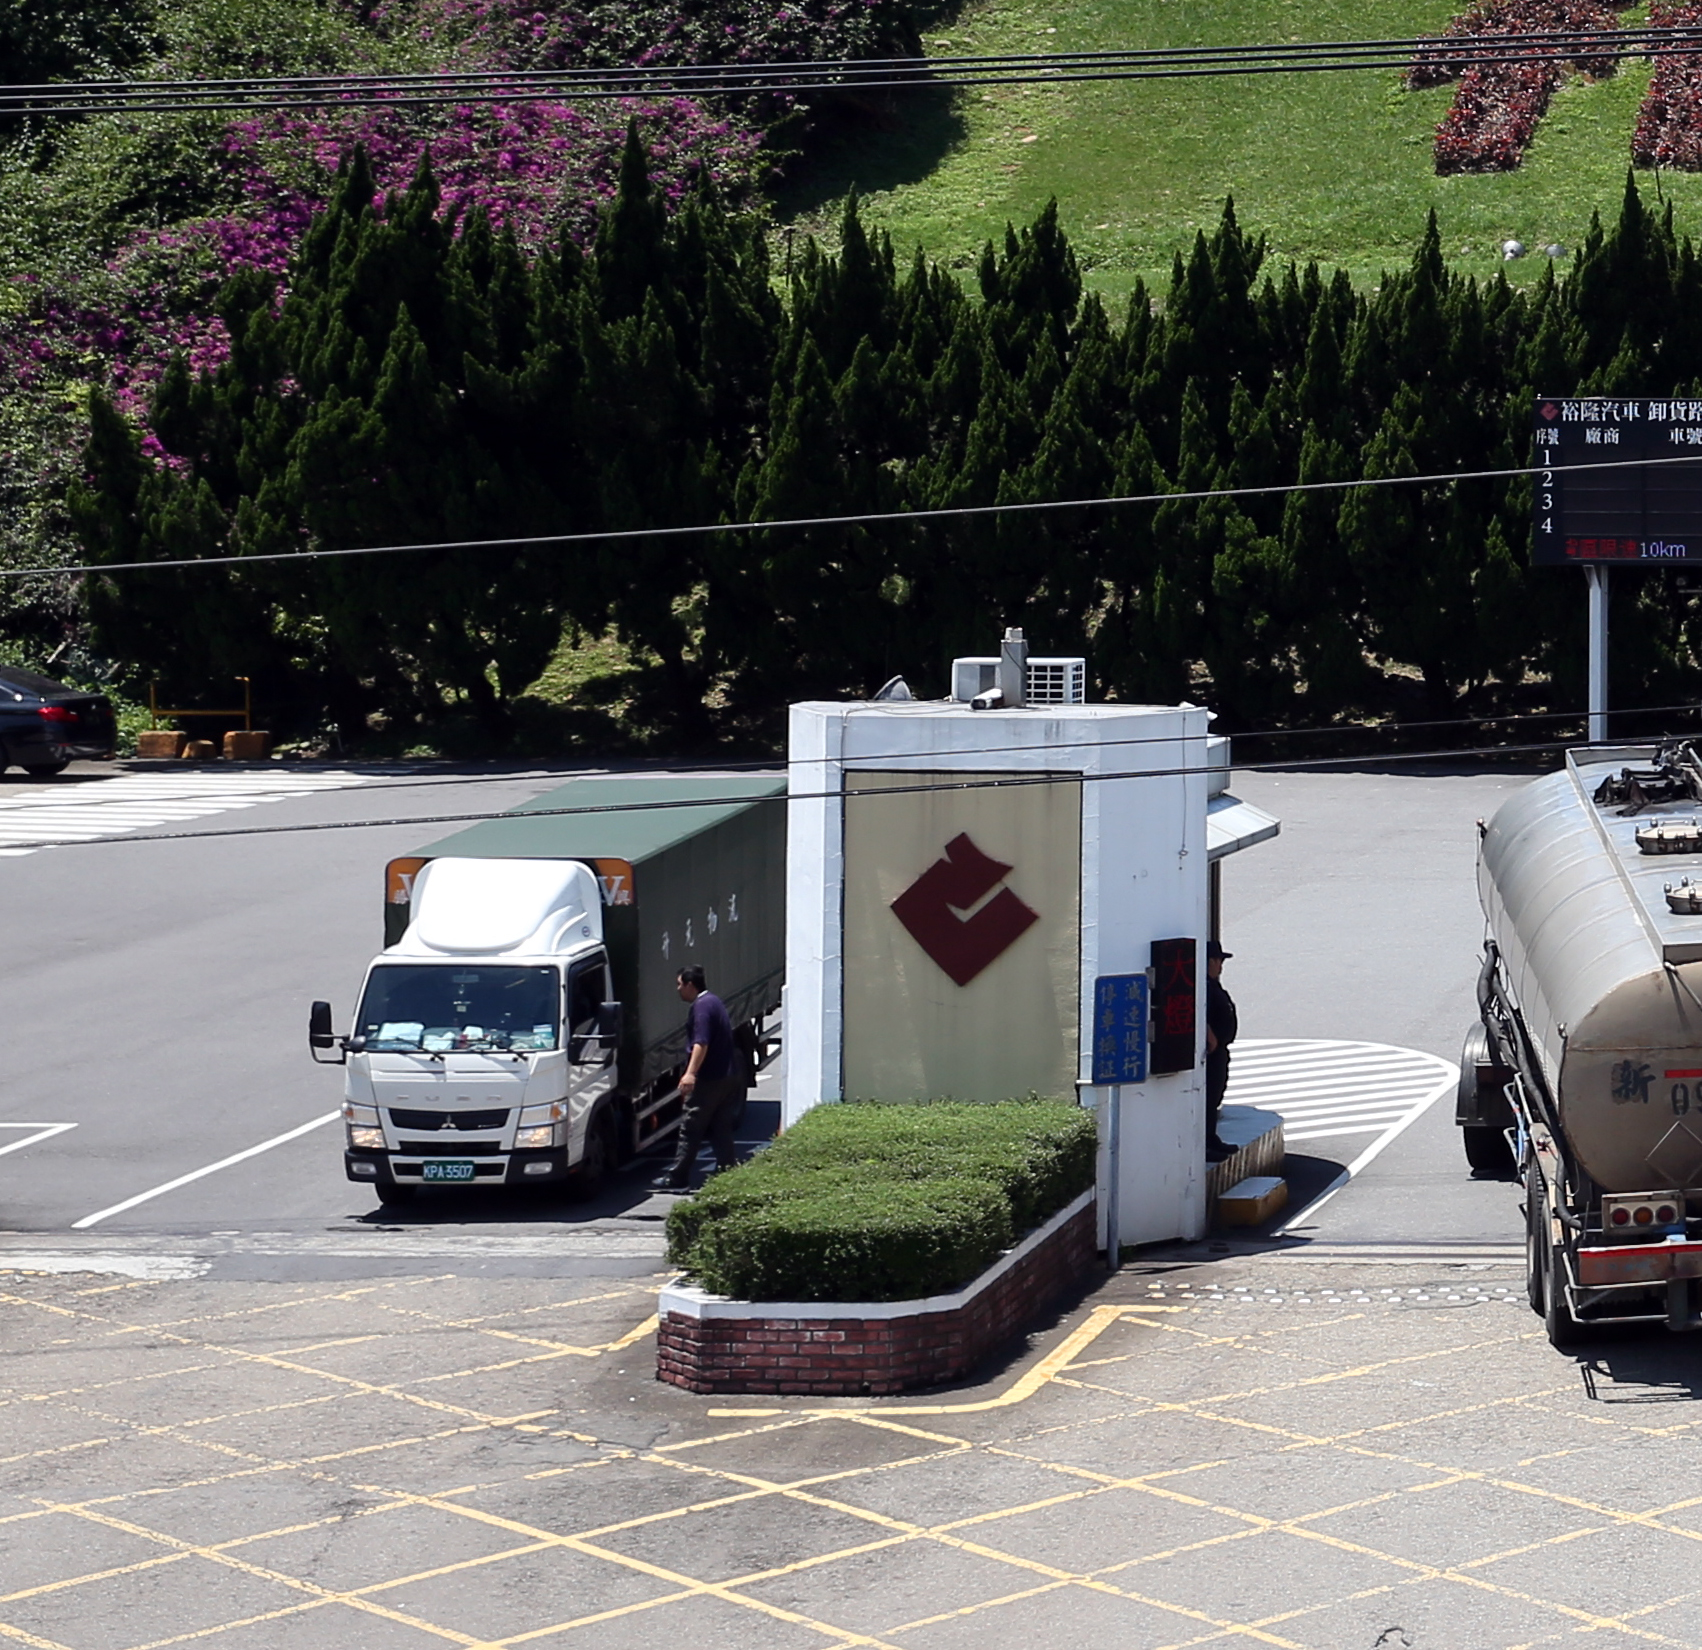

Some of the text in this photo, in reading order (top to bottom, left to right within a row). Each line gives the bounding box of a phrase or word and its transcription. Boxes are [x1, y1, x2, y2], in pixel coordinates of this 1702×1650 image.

[1561, 401, 1641, 422] 裕隆汽車
[1536, 429, 1560, 445] 序號
[1585, 427, 1620, 445] 廠商
[1543, 450, 1551, 466] 1
[1542, 471, 1554, 487] 2
[1542, 494, 1553, 510] 3
[1541, 517, 1553, 534] 4
